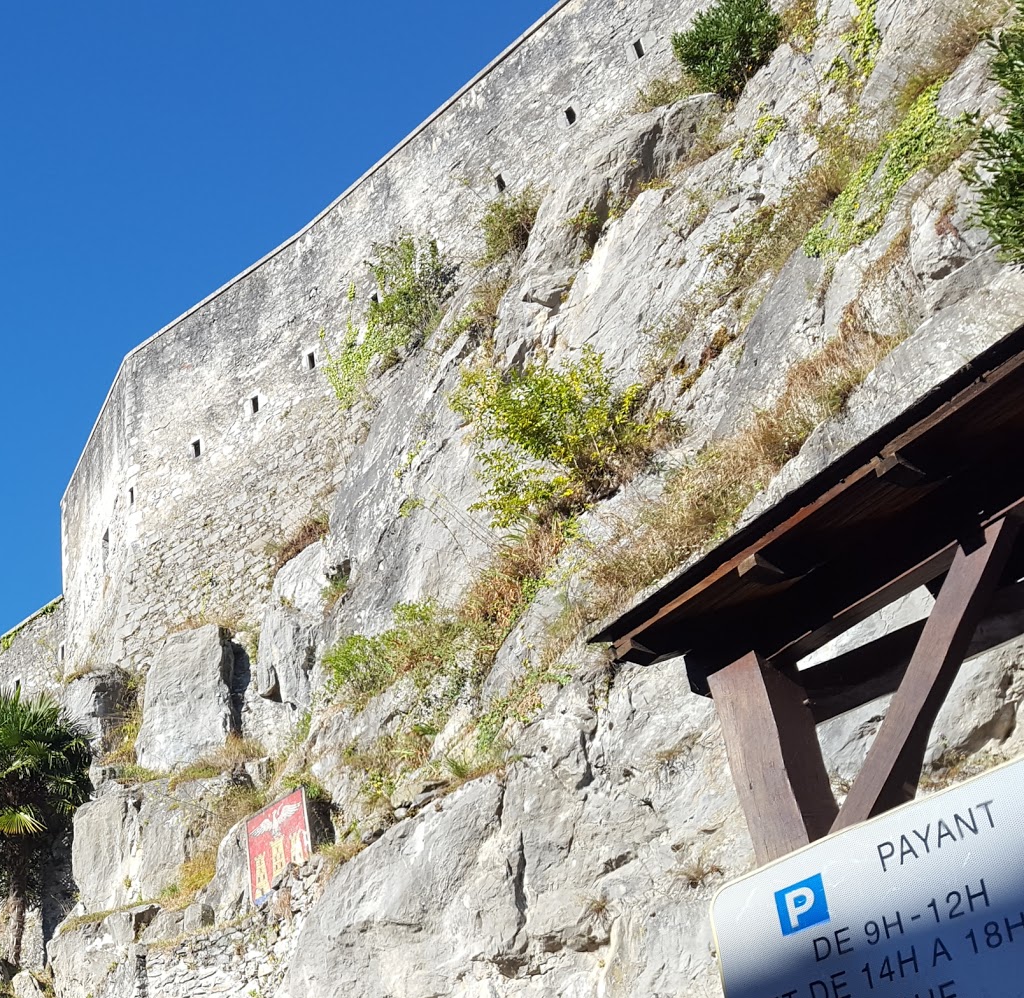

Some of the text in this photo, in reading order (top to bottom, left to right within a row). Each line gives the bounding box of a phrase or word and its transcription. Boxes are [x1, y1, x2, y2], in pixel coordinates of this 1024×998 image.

[877, 800, 995, 873] PAYANT
[784, 886, 815, 929] P
[812, 879, 990, 963] DE 9H-12H
[861, 944, 919, 990] 14H
[932, 937, 953, 968] A
[964, 911, 1024, 955] 18H
